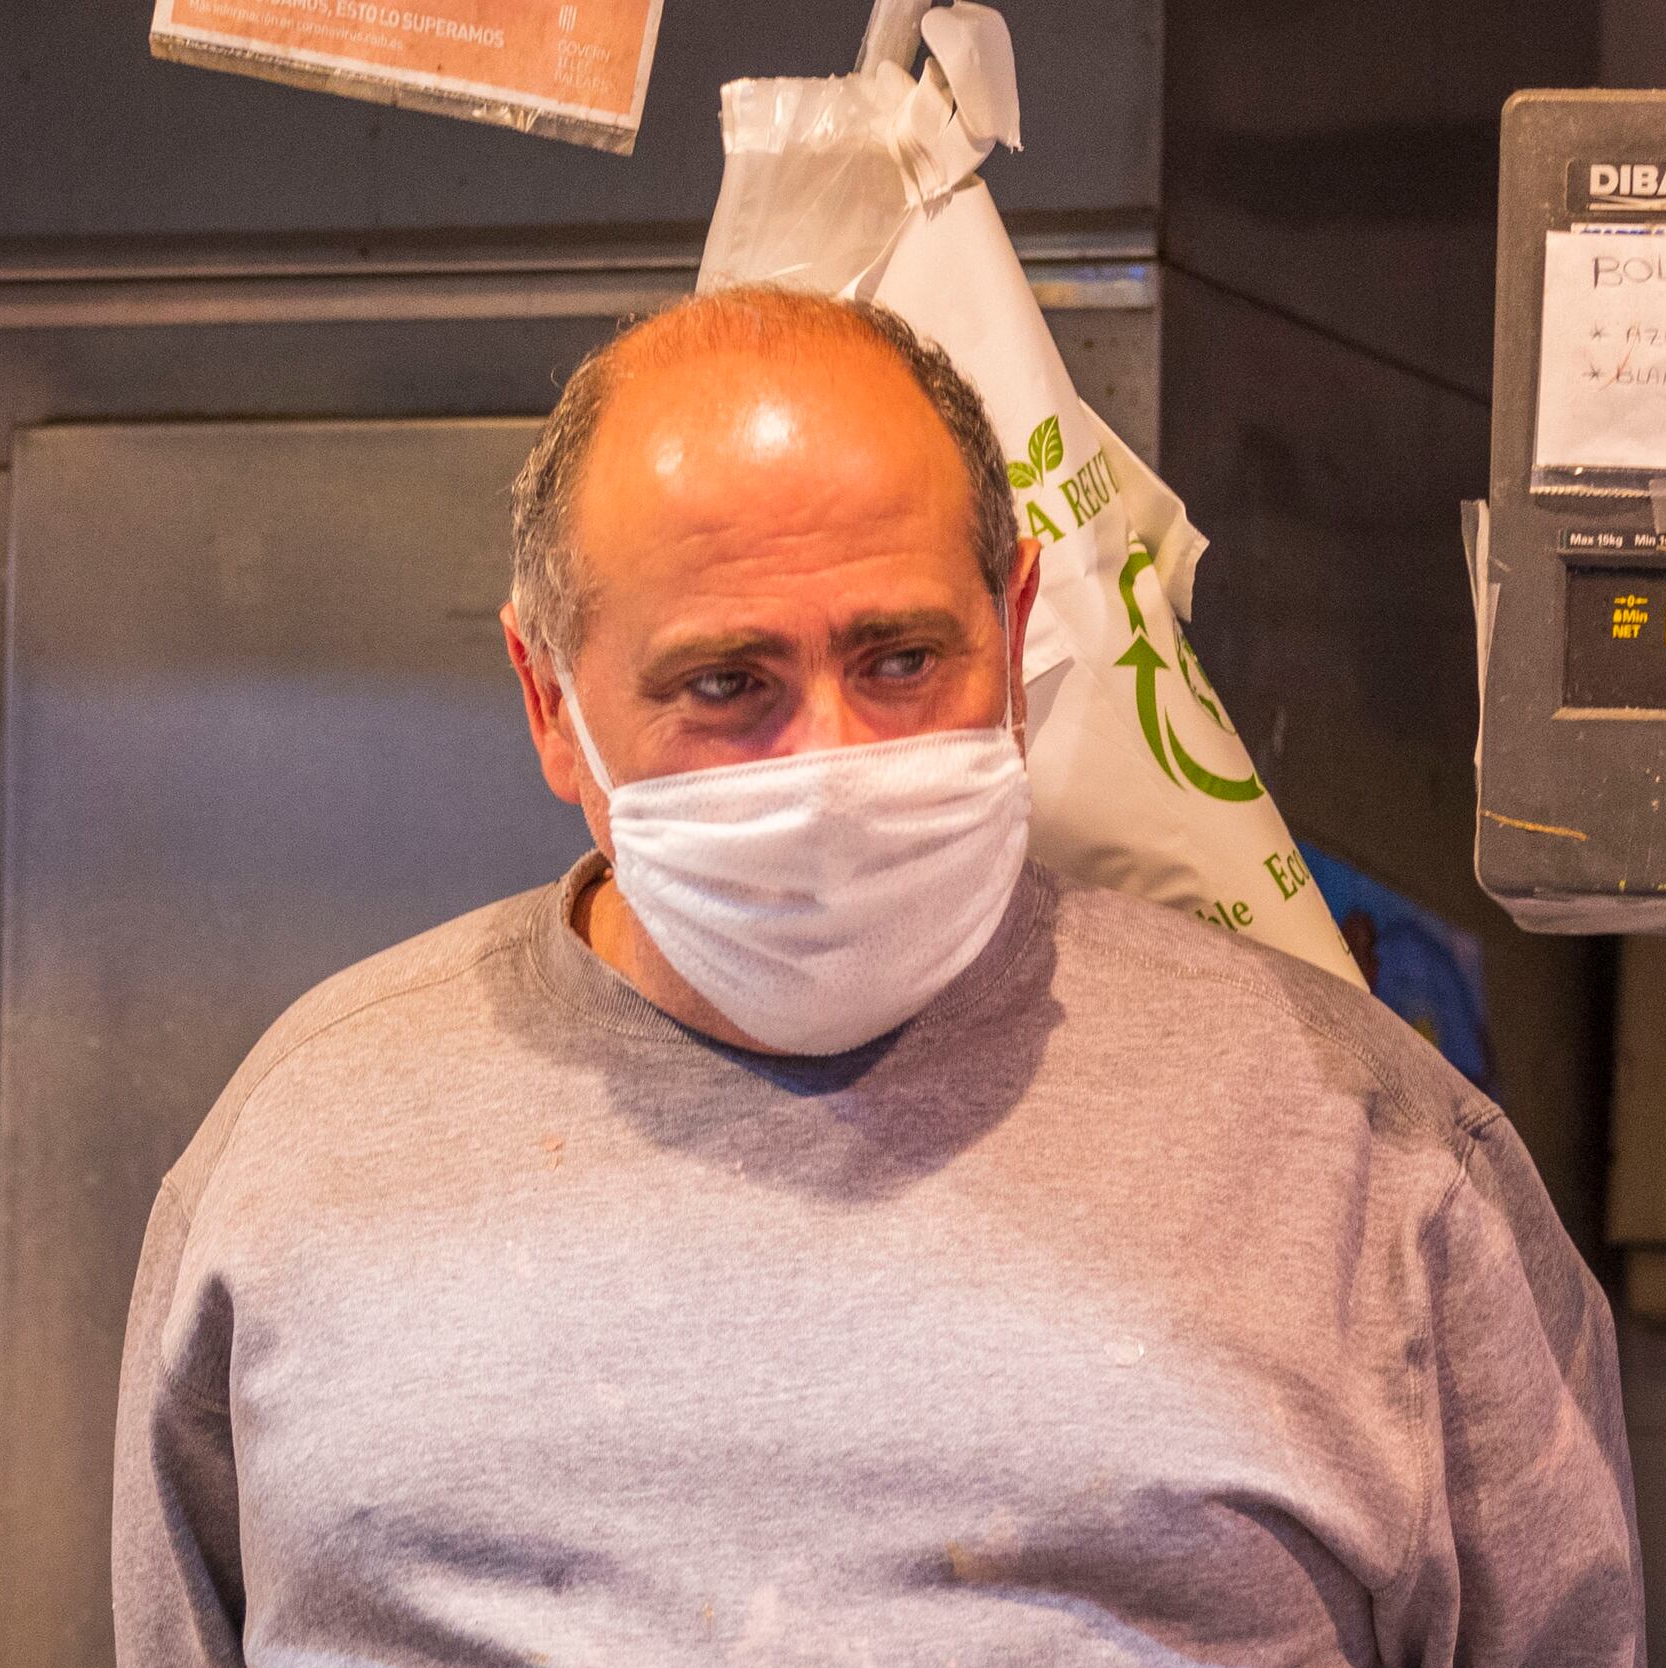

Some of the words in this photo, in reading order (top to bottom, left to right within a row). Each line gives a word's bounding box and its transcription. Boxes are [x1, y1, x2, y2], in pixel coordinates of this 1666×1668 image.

[336, 3, 377, 22] ESTO
[380, 9, 400, 28] LO
[402, 13, 505, 49] SUPERAMOS
[1570, 532, 1594, 546] Max
[1634, 533, 1657, 546] Min
[1622, 609, 1649, 624] Min
[1612, 624, 1641, 639] NET
